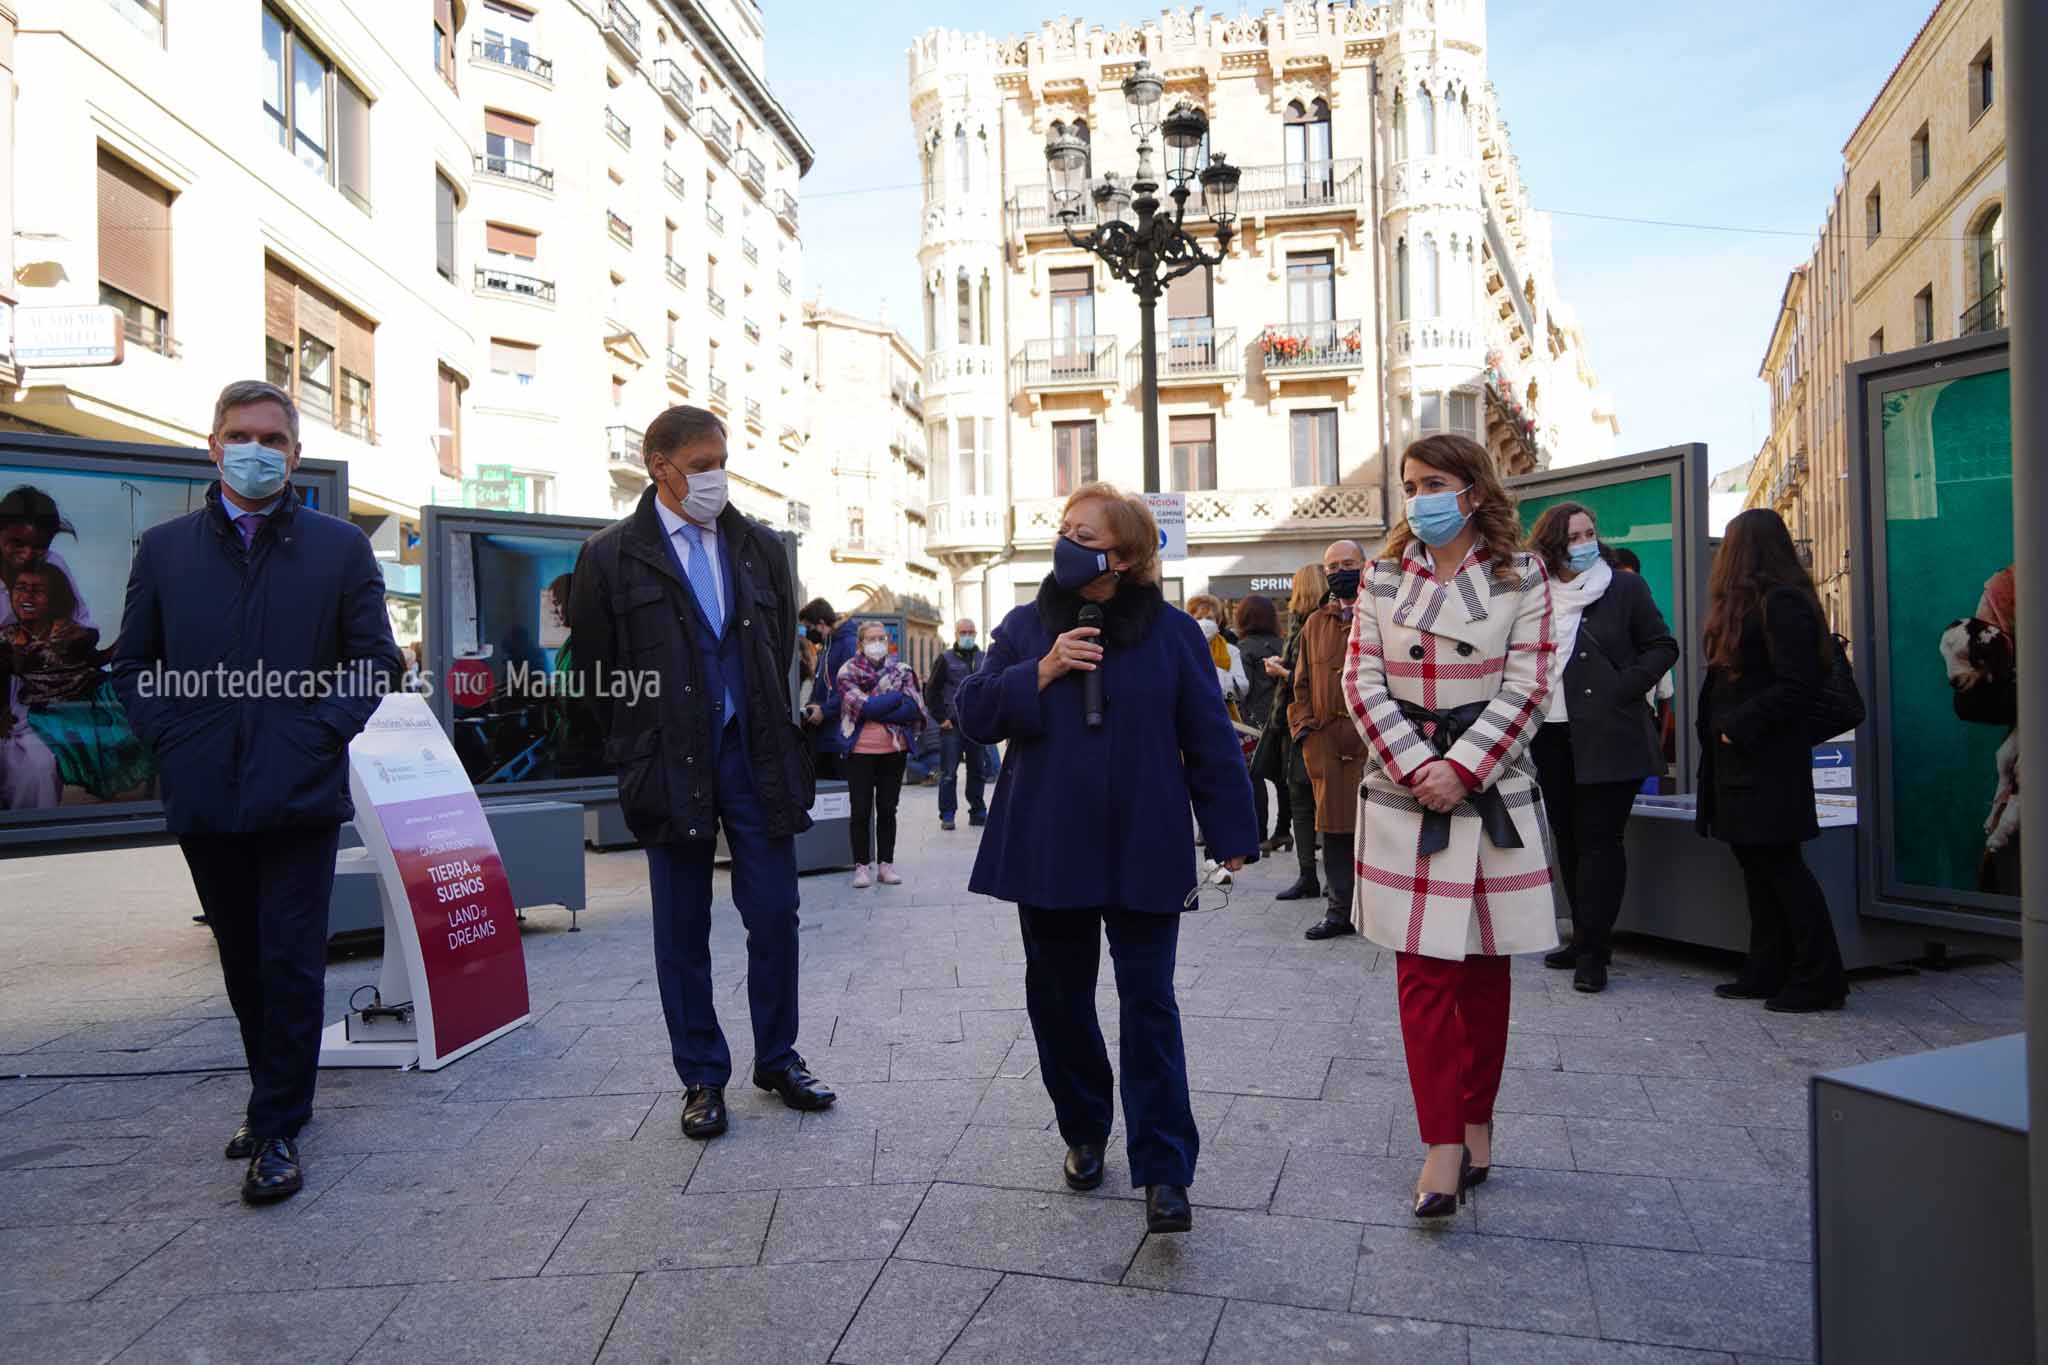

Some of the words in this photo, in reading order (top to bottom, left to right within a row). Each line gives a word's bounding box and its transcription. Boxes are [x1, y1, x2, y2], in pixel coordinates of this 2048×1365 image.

[1148, 498, 1179, 506] NCIÓN
[1250, 577, 1293, 591] SPRIN
[427, 860, 473, 884] TIERRA
[471, 863, 481, 874] de
[436, 877, 485, 903] SUEÑOS
[447, 904, 480, 928] LAND
[447, 919, 496, 950] DREAMS
